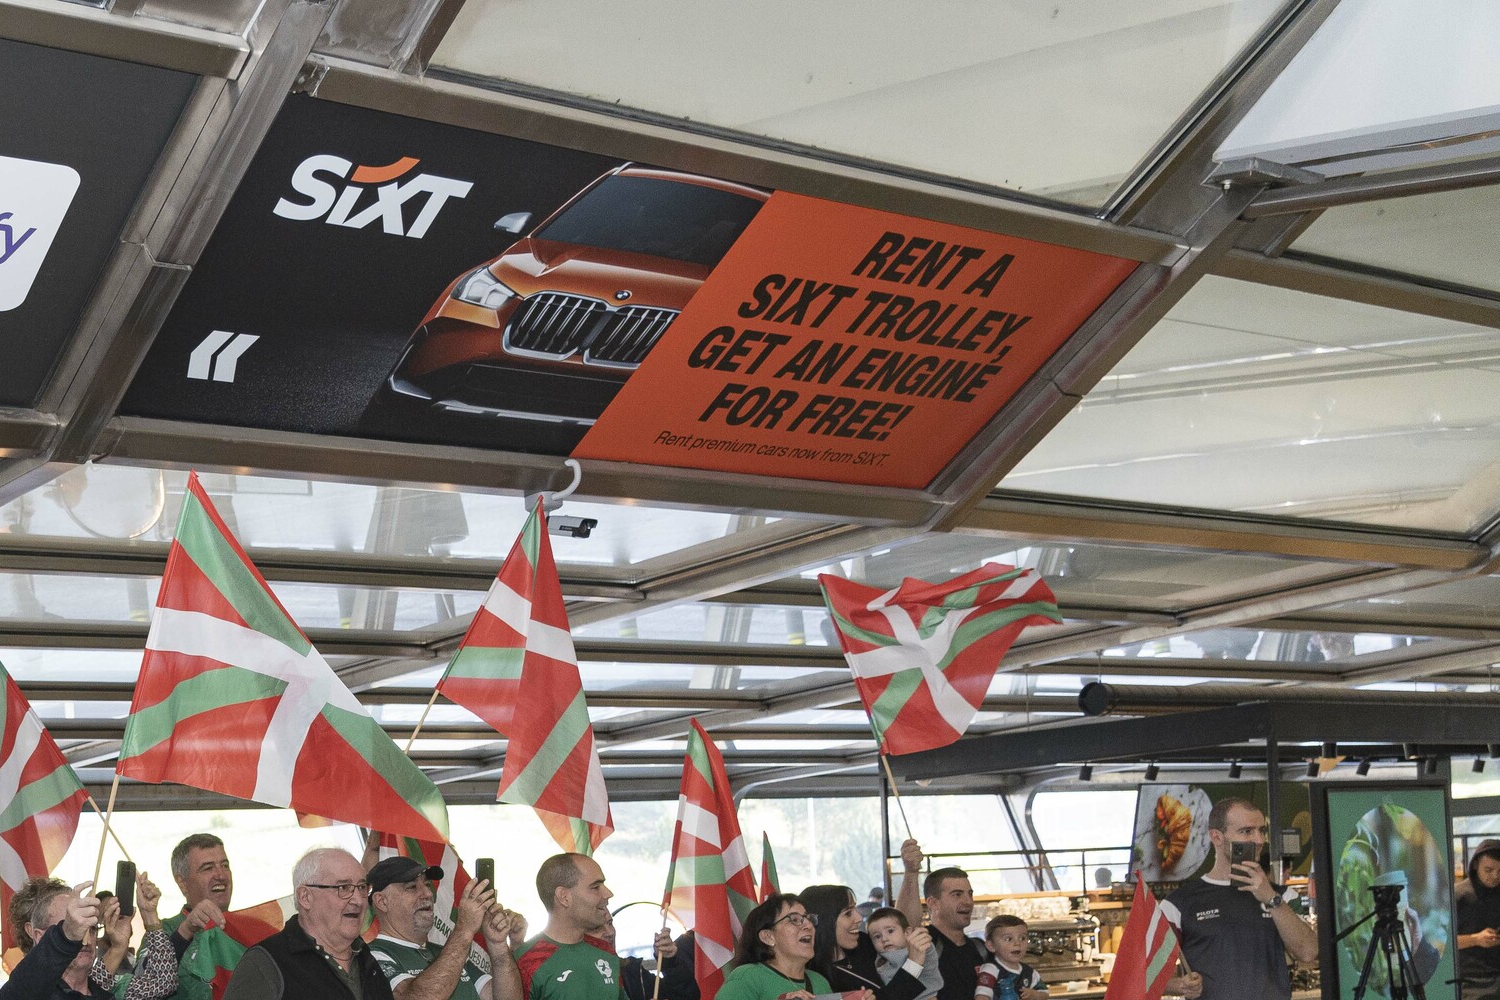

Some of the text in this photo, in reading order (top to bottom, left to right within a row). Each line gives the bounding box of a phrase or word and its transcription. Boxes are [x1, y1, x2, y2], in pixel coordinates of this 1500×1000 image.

[851, 231, 1016, 298] RENT A
[737, 273, 1032, 364] SIXT TROLLEY,
[687, 325, 1004, 403] GET AN ENGINE
[698, 382, 916, 442] FOR FREE!
[653, 430, 694, 447] Rent
[688, 434, 758, 455] premium
[756, 444, 789, 457] cars
[787, 448, 819, 460] now
[817, 448, 854, 464] from
